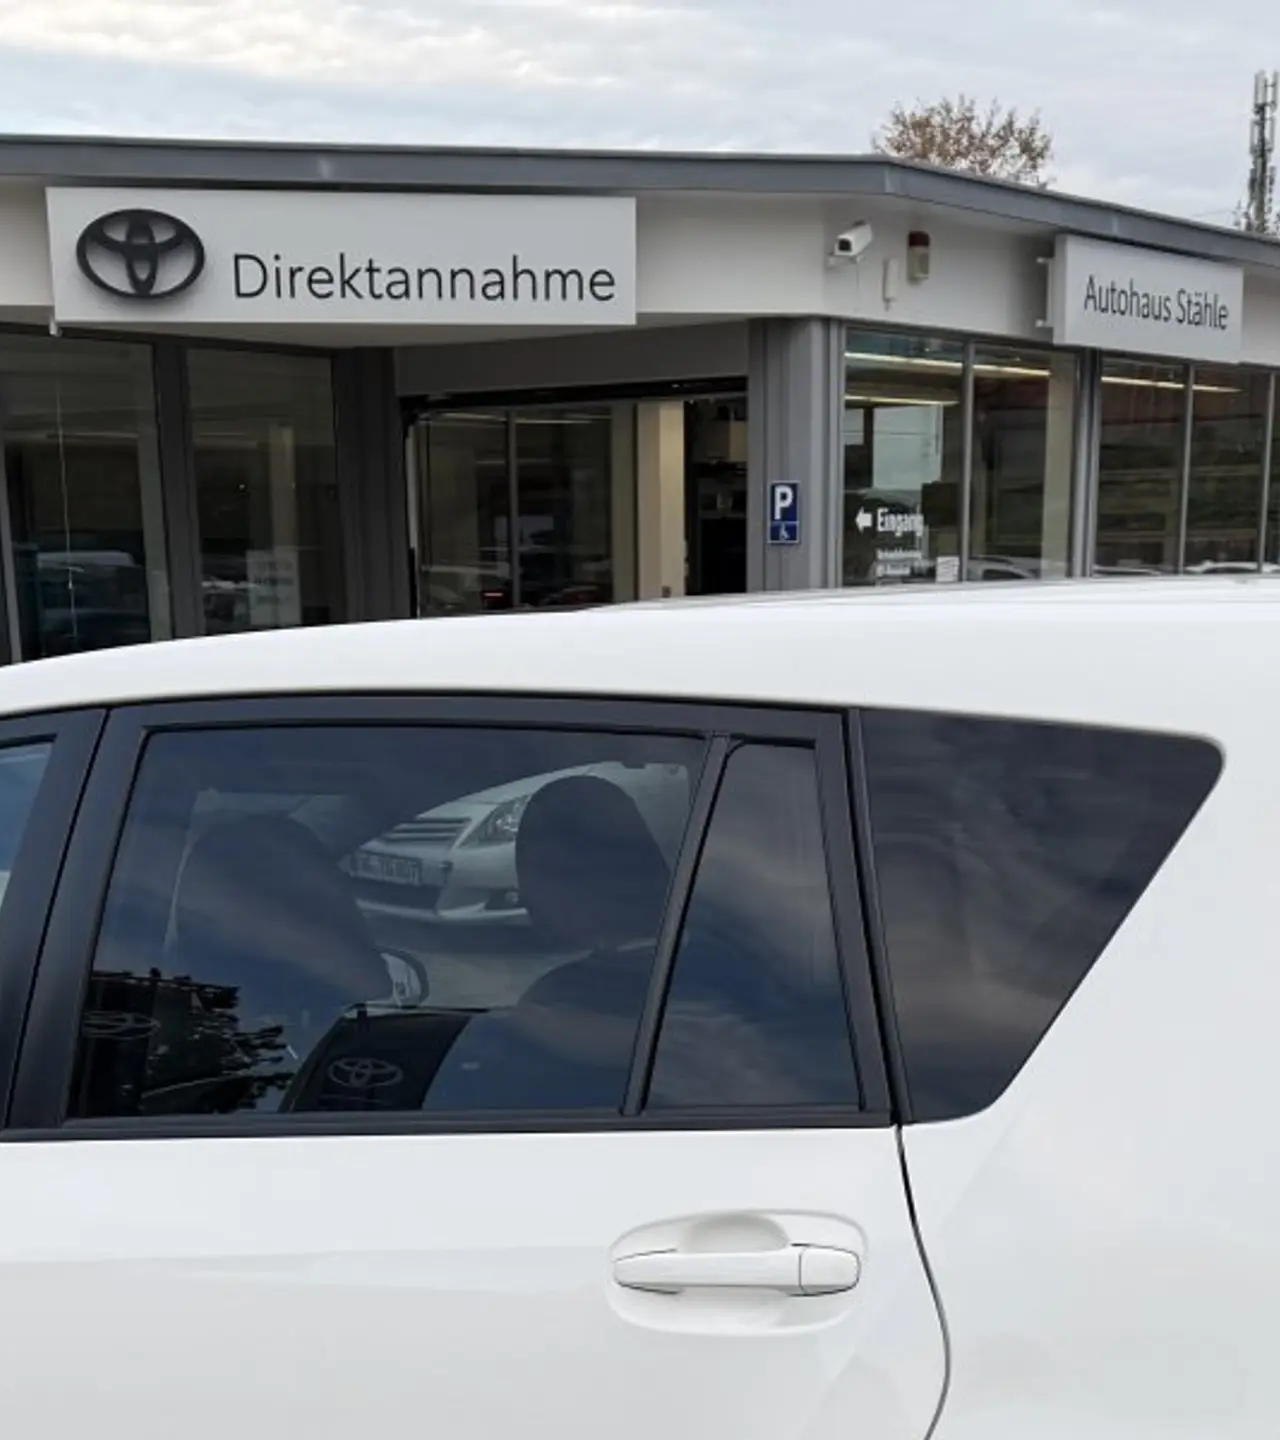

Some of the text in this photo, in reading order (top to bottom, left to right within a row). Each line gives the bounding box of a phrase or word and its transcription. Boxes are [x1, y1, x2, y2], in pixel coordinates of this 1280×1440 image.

[233, 252, 616, 301] Direktannahme
[1083, 273, 1230, 331] Autohaus Stähle
[774, 485, 794, 521] P
[877, 507, 924, 537] Eingang
